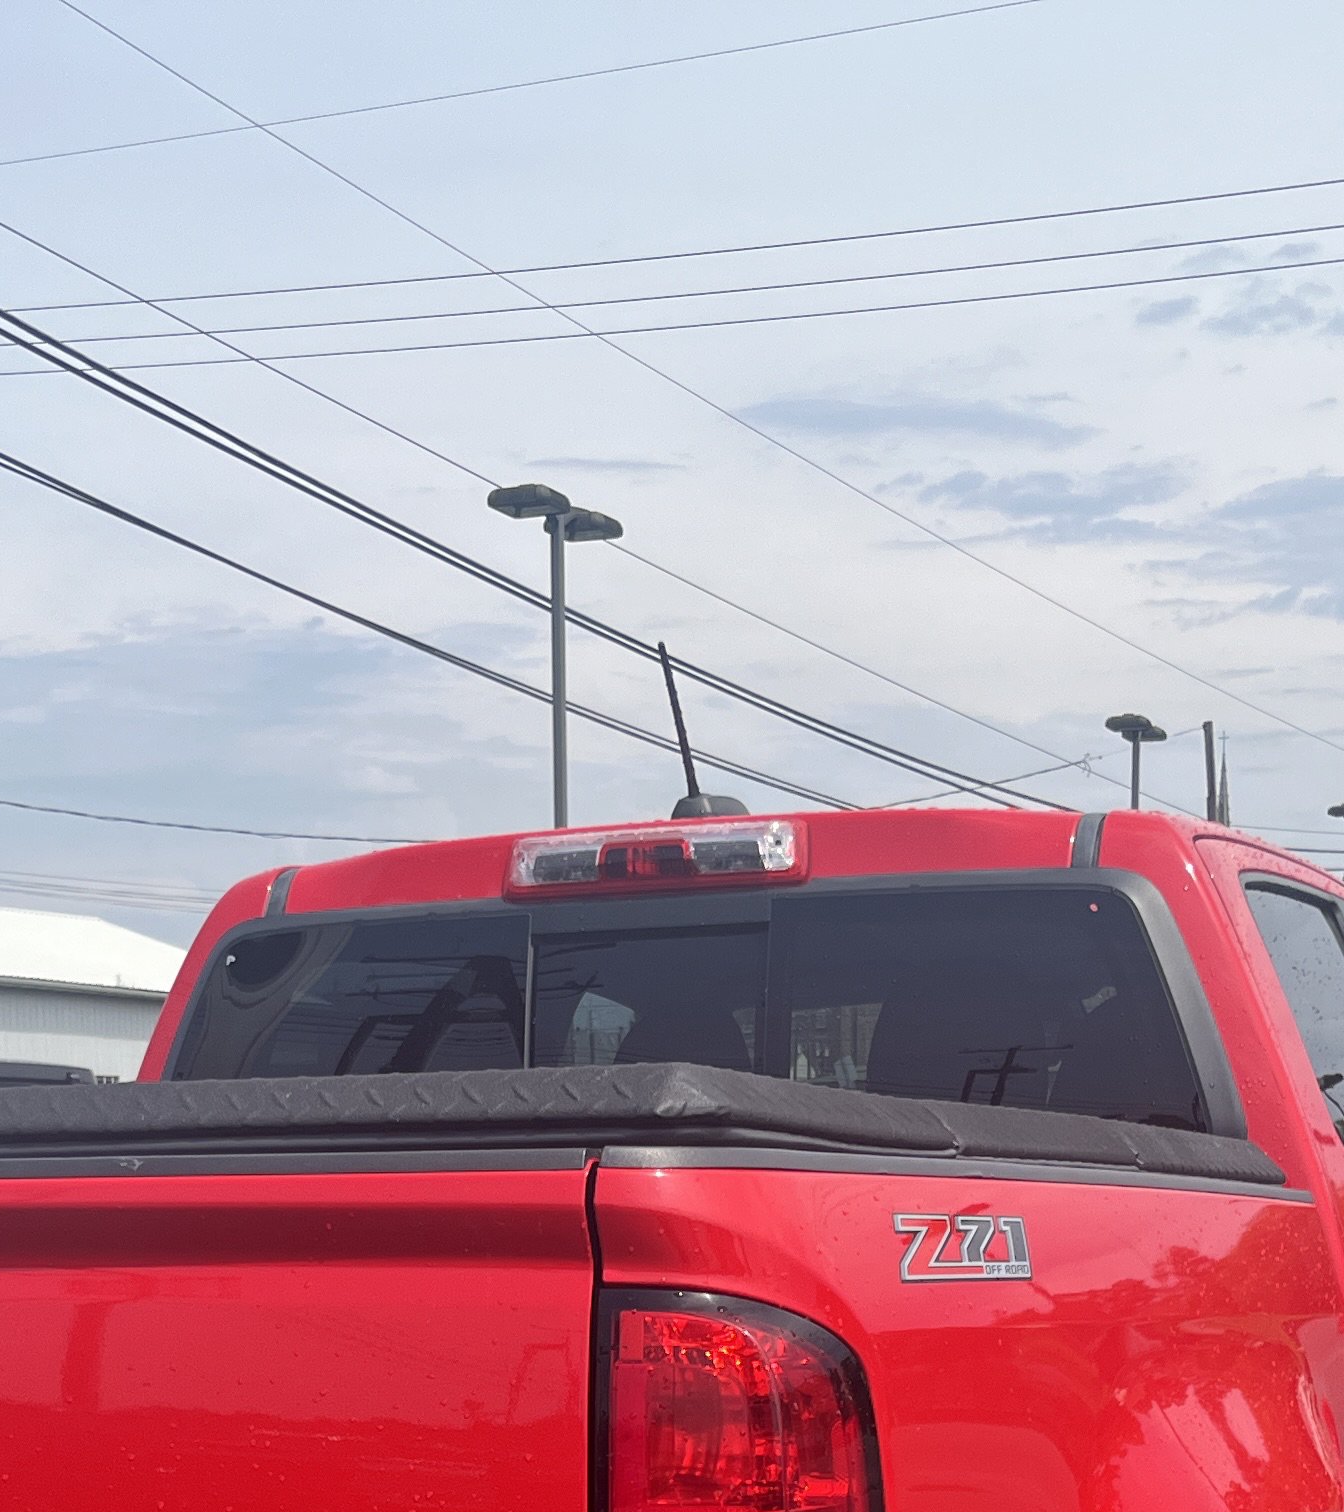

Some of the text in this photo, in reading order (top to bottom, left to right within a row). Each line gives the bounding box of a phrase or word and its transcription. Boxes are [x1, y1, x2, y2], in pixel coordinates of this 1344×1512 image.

[893, 1212, 1033, 1283] Z71
[985, 1264, 1029, 1275] OFF ROAD
